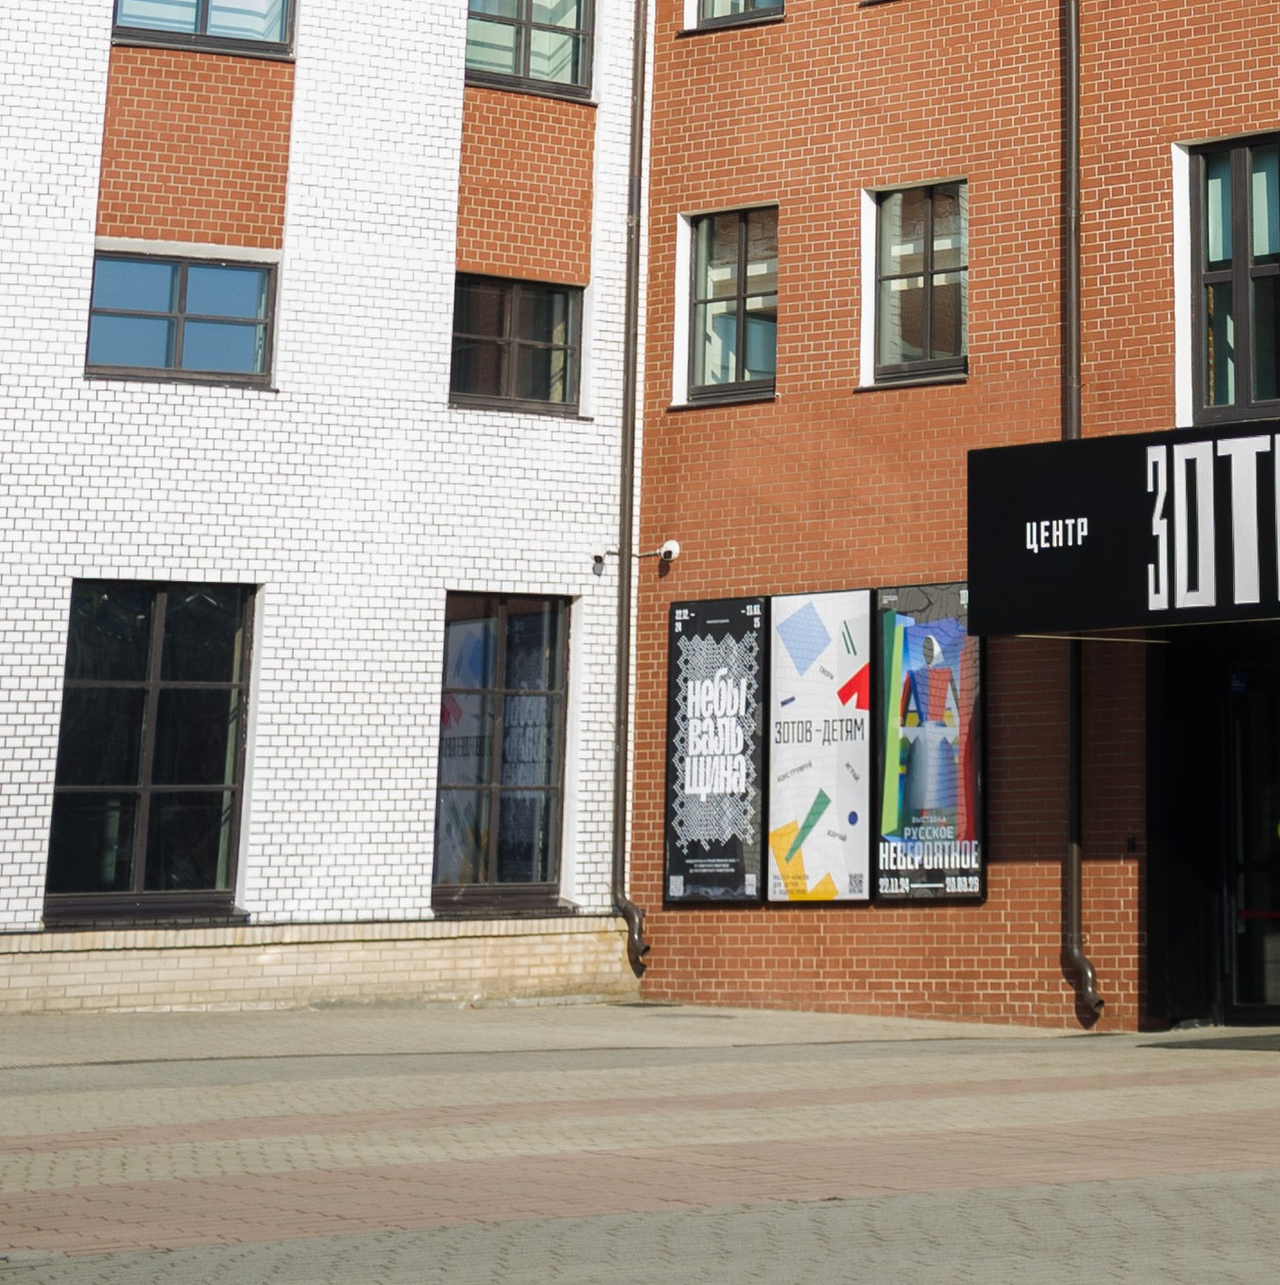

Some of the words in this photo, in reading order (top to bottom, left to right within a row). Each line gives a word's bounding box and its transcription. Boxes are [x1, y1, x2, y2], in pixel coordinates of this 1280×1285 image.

[1026, 518, 1088, 554] ЦЕНТР
[687, 668, 746, 718] небы
[688, 716, 743, 756] валь
[685, 754, 746, 802] щина
[903, 826, 954, 840] РУССКОЕ
[879, 840, 980, 870] НЕВЕРОЯТНОЕ
